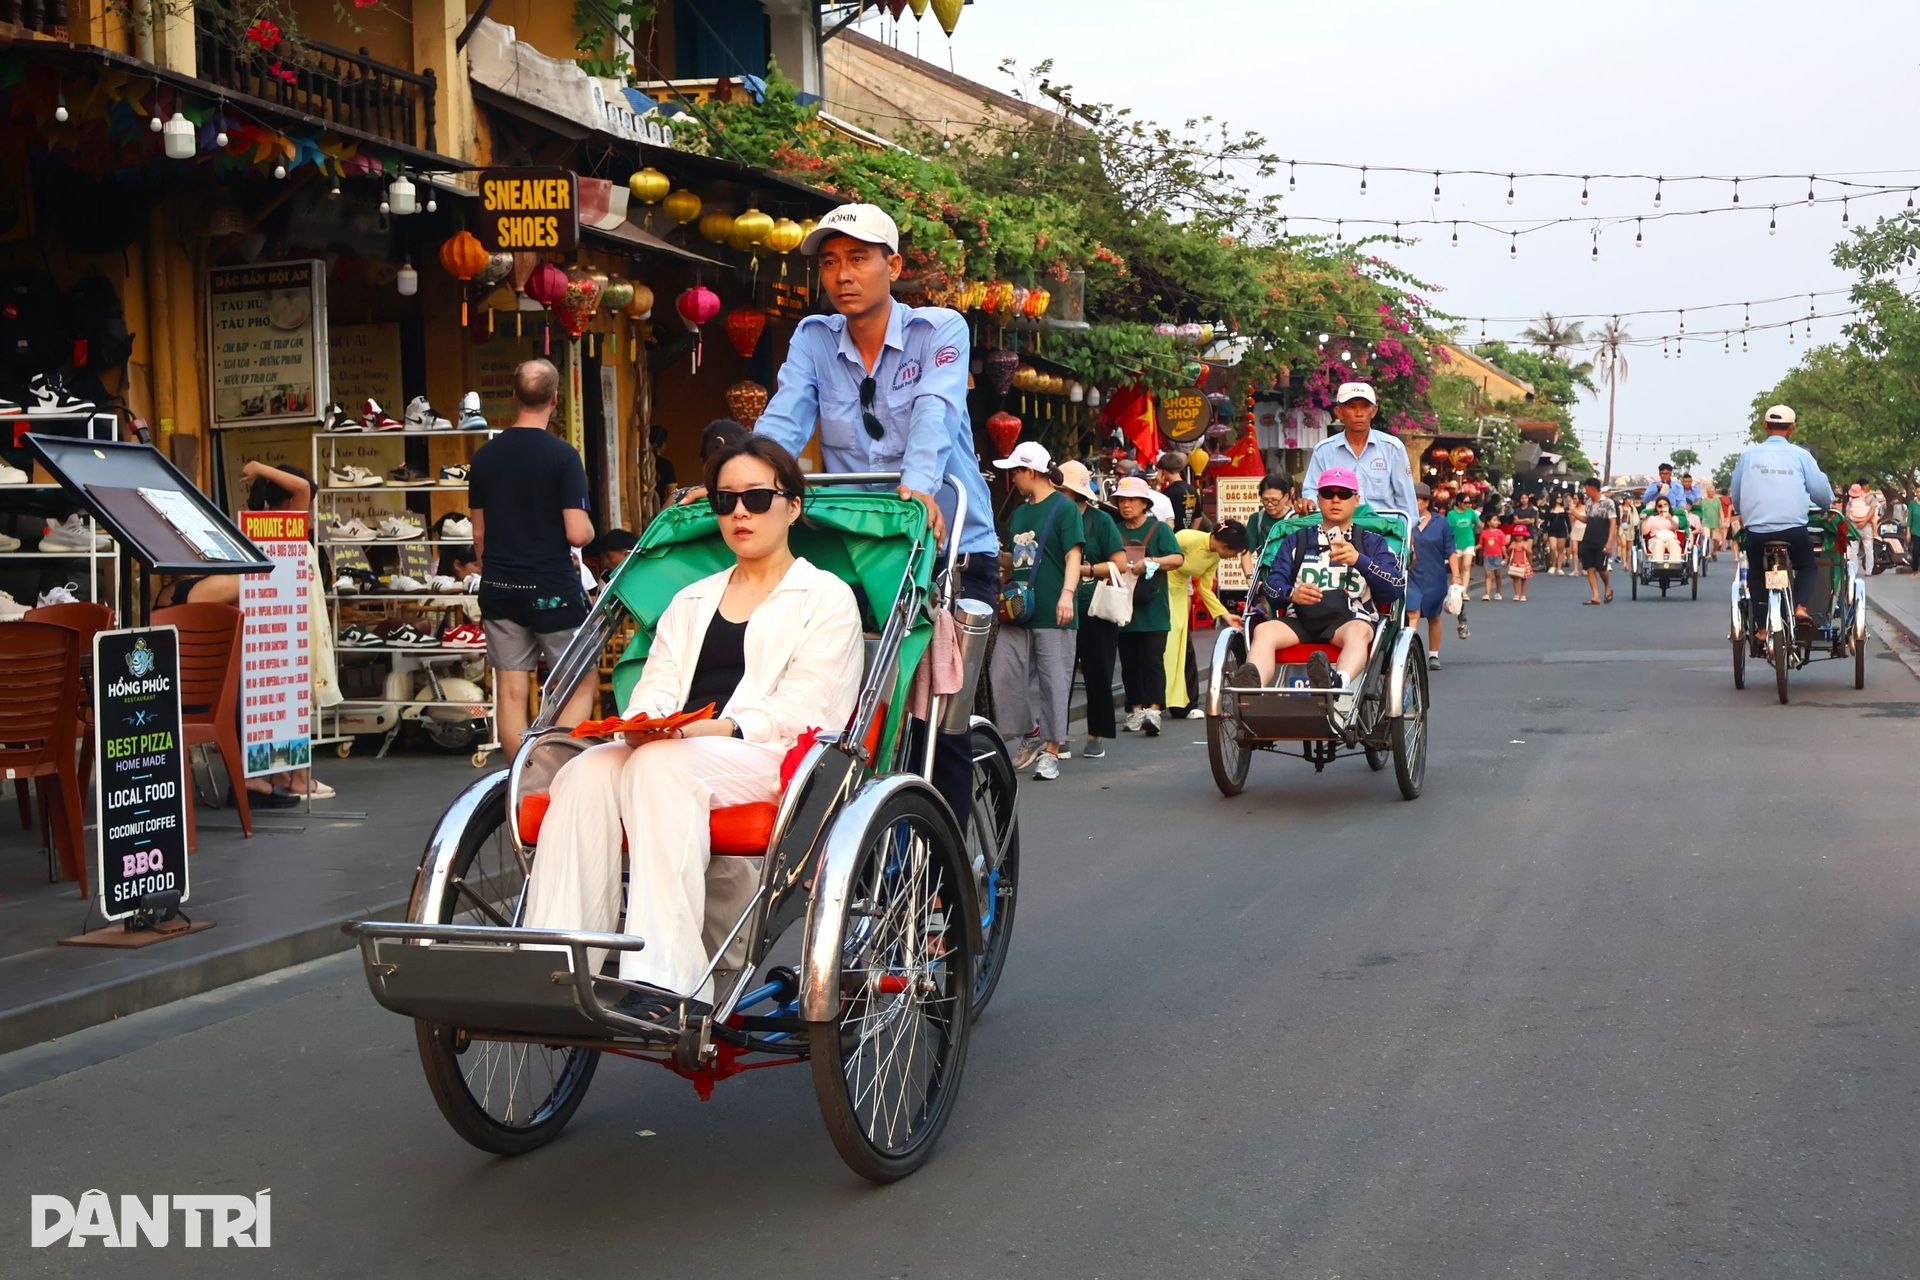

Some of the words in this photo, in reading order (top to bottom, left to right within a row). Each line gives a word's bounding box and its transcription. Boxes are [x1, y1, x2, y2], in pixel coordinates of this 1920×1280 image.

[484, 179, 570, 211] SNEAKER
[497, 216, 559, 248] SHOES
[1163, 396, 1202, 408] SHOES
[1167, 408, 1200, 420] SHOP
[246, 517, 284, 538] PRIVATE
[286, 518, 304, 538] CAR
[108, 676, 140, 697] HỒNG
[142, 674, 170, 694] PHÚC
[124, 694, 156, 703] RESTAURANT
[107, 736, 138, 759] BEST
[141, 731, 173, 753] PIZZA
[116, 758, 140, 772] HOME
[142, 754, 166, 767] MADE
[108, 786, 142, 809] LOCAL
[145, 782, 175, 802] FOOD
[109, 821, 144, 840] COCONUT
[146, 815, 176, 832] COFFEE
[123, 848, 164, 878] BBQ
[114, 872, 175, 902] SEAFOOD
